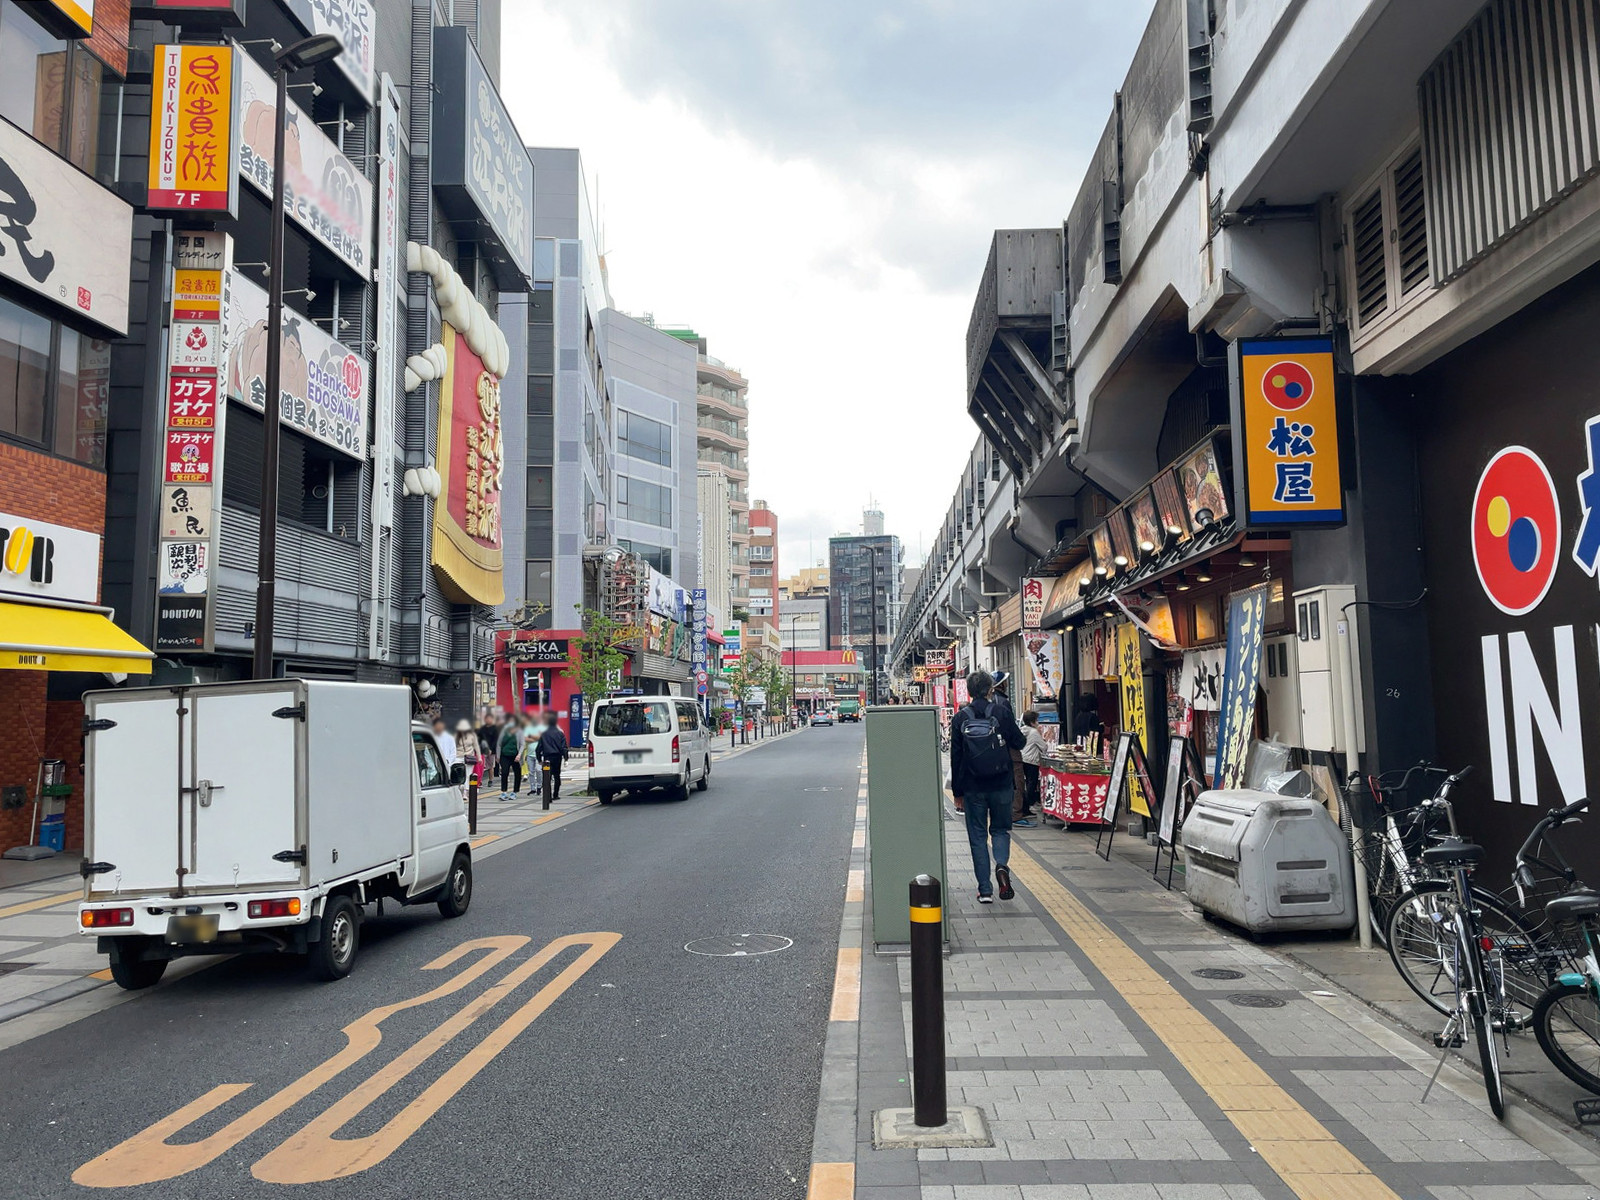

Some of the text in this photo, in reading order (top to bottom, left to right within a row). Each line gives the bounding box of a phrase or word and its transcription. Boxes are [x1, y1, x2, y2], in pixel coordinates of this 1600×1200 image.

[163, 53, 178, 174] TORIKIZOKU
[182, 55, 221, 182] 鳥貴族
[175, 192, 201, 206] 7F
[178, 251, 222, 259] ビルディング
[174, 379, 214, 397] カラ
[308, 360, 348, 398] Chanko
[173, 398, 213, 416] オケ
[307, 381, 361, 426] EDOSAWA
[170, 433, 213, 444] カラオケ
[170, 462, 210, 473] 歌広場
[1266, 417, 1316, 503] 松屋
[1024, 579, 1043, 600] 肉
[161, 609, 203, 620] DOUTOR
[18, 655, 46, 665] DOUTOR
[1076, 783, 1091, 821] コロッケ
[71, 931, 623, 1188] 30
